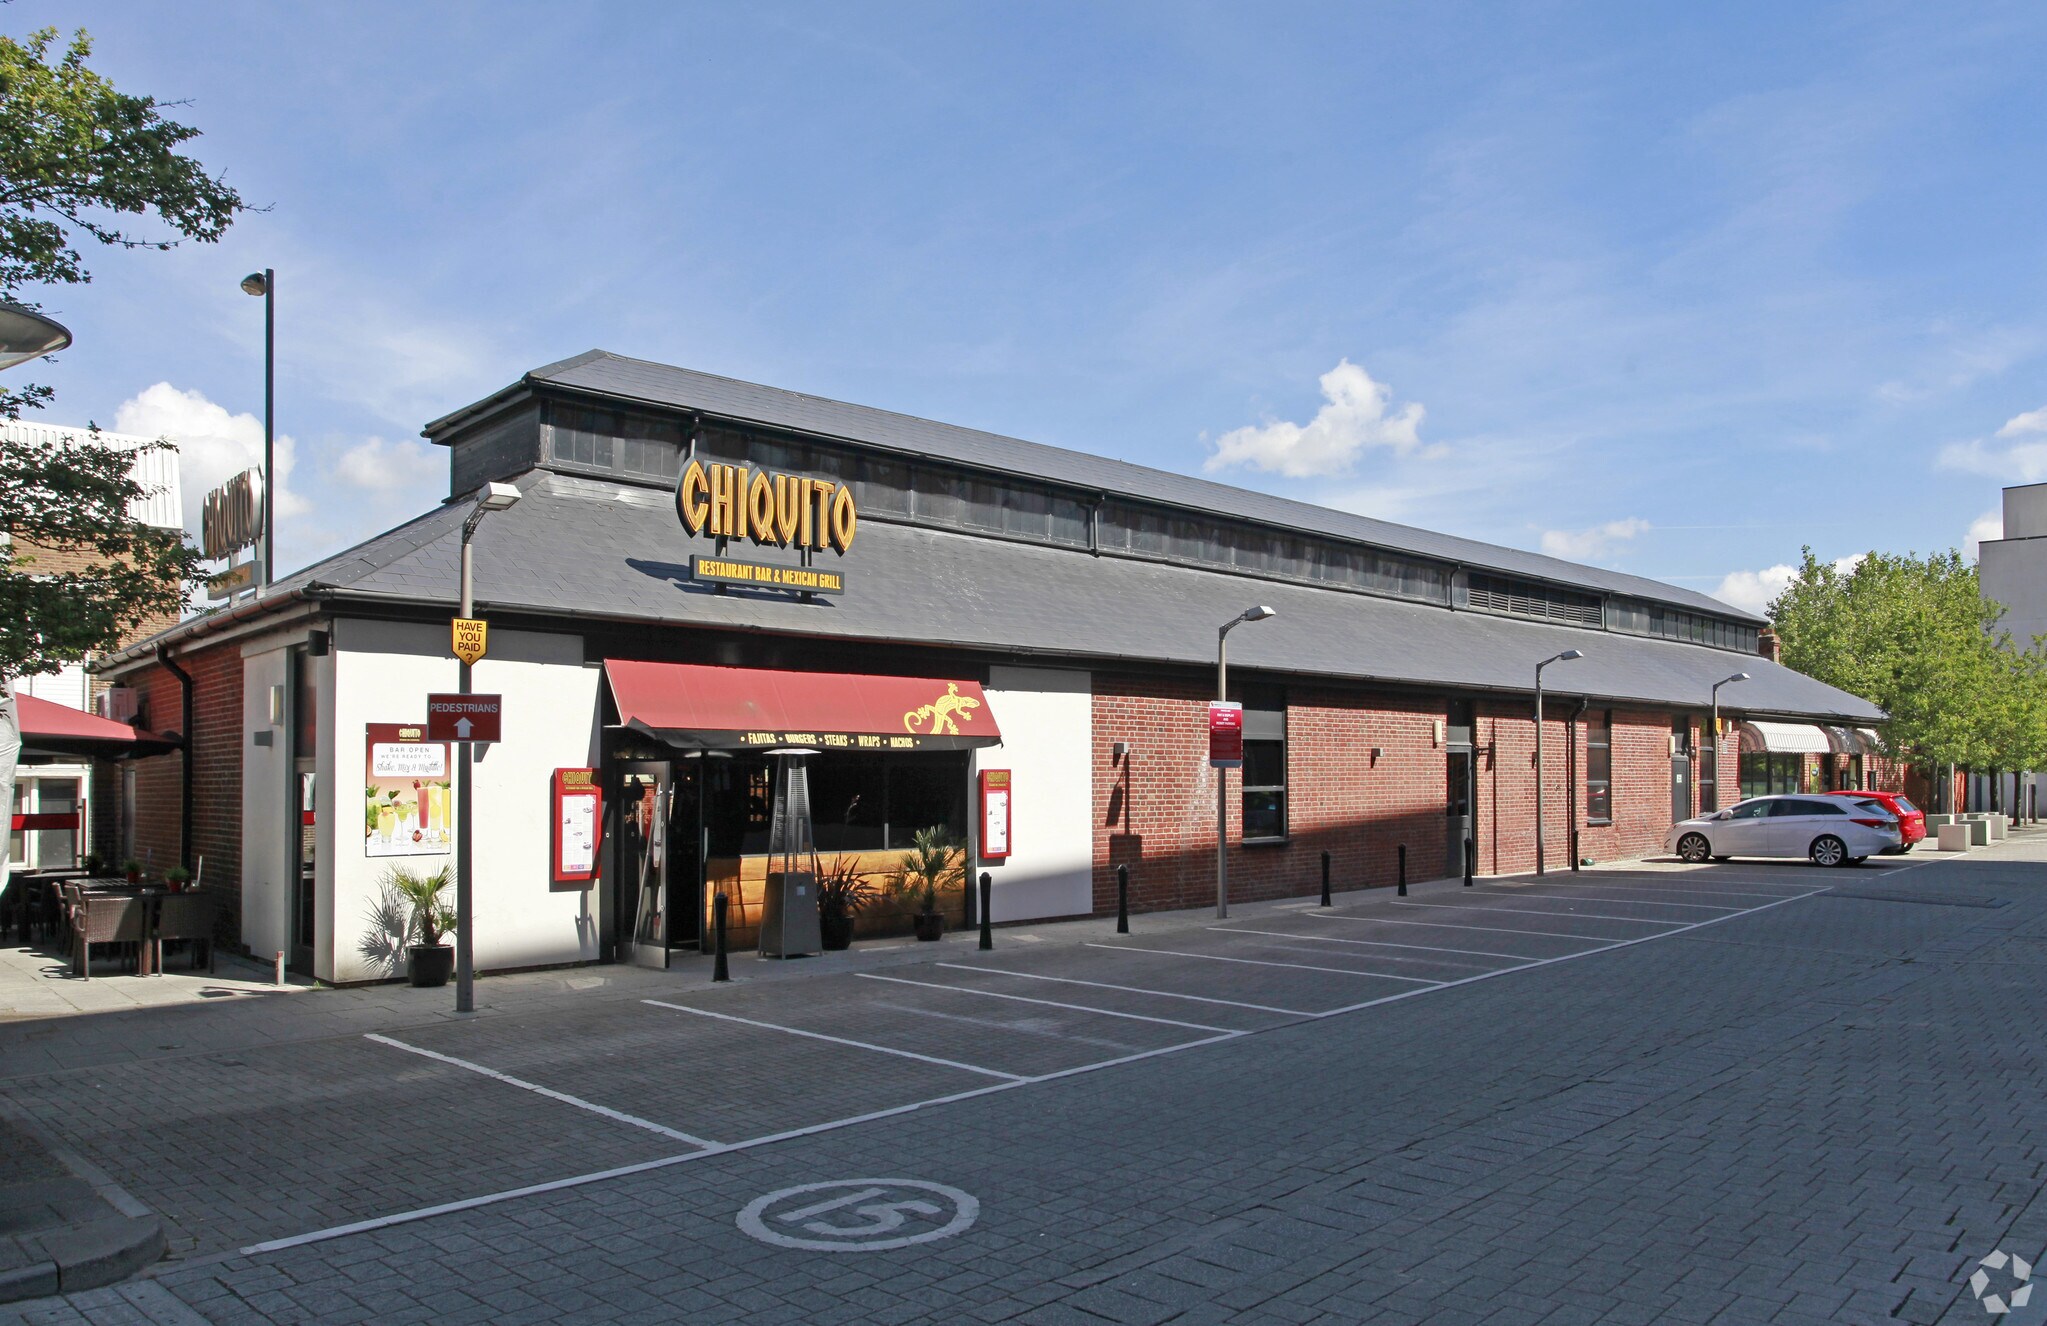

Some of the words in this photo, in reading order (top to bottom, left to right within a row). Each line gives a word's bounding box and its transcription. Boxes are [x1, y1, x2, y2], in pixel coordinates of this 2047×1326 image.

[678, 458, 857, 555] CHIQUITO
[698, 559, 754, 581] RESTAURANT
[755, 567, 773, 582] BAR
[773, 569, 781, 583] &
[782, 569, 818, 588] MEXICAN
[819, 574, 841, 590] GRILL
[456, 622, 483, 632] HAVE
[459, 632, 481, 642] YOU
[458, 642, 481, 652] PAID
[465, 653, 473, 664] ?
[430, 703, 498, 713] PEDESTRIANS
[747, 732, 777, 745] FAJITAS
[784, 733, 817, 745] BURGERS
[824, 734, 848, 747] STEAKS
[857, 735, 881, 747] WRAPS
[890, 737, 914, 748] NACHOS
[561, 771, 593, 785] CHIQUIT
